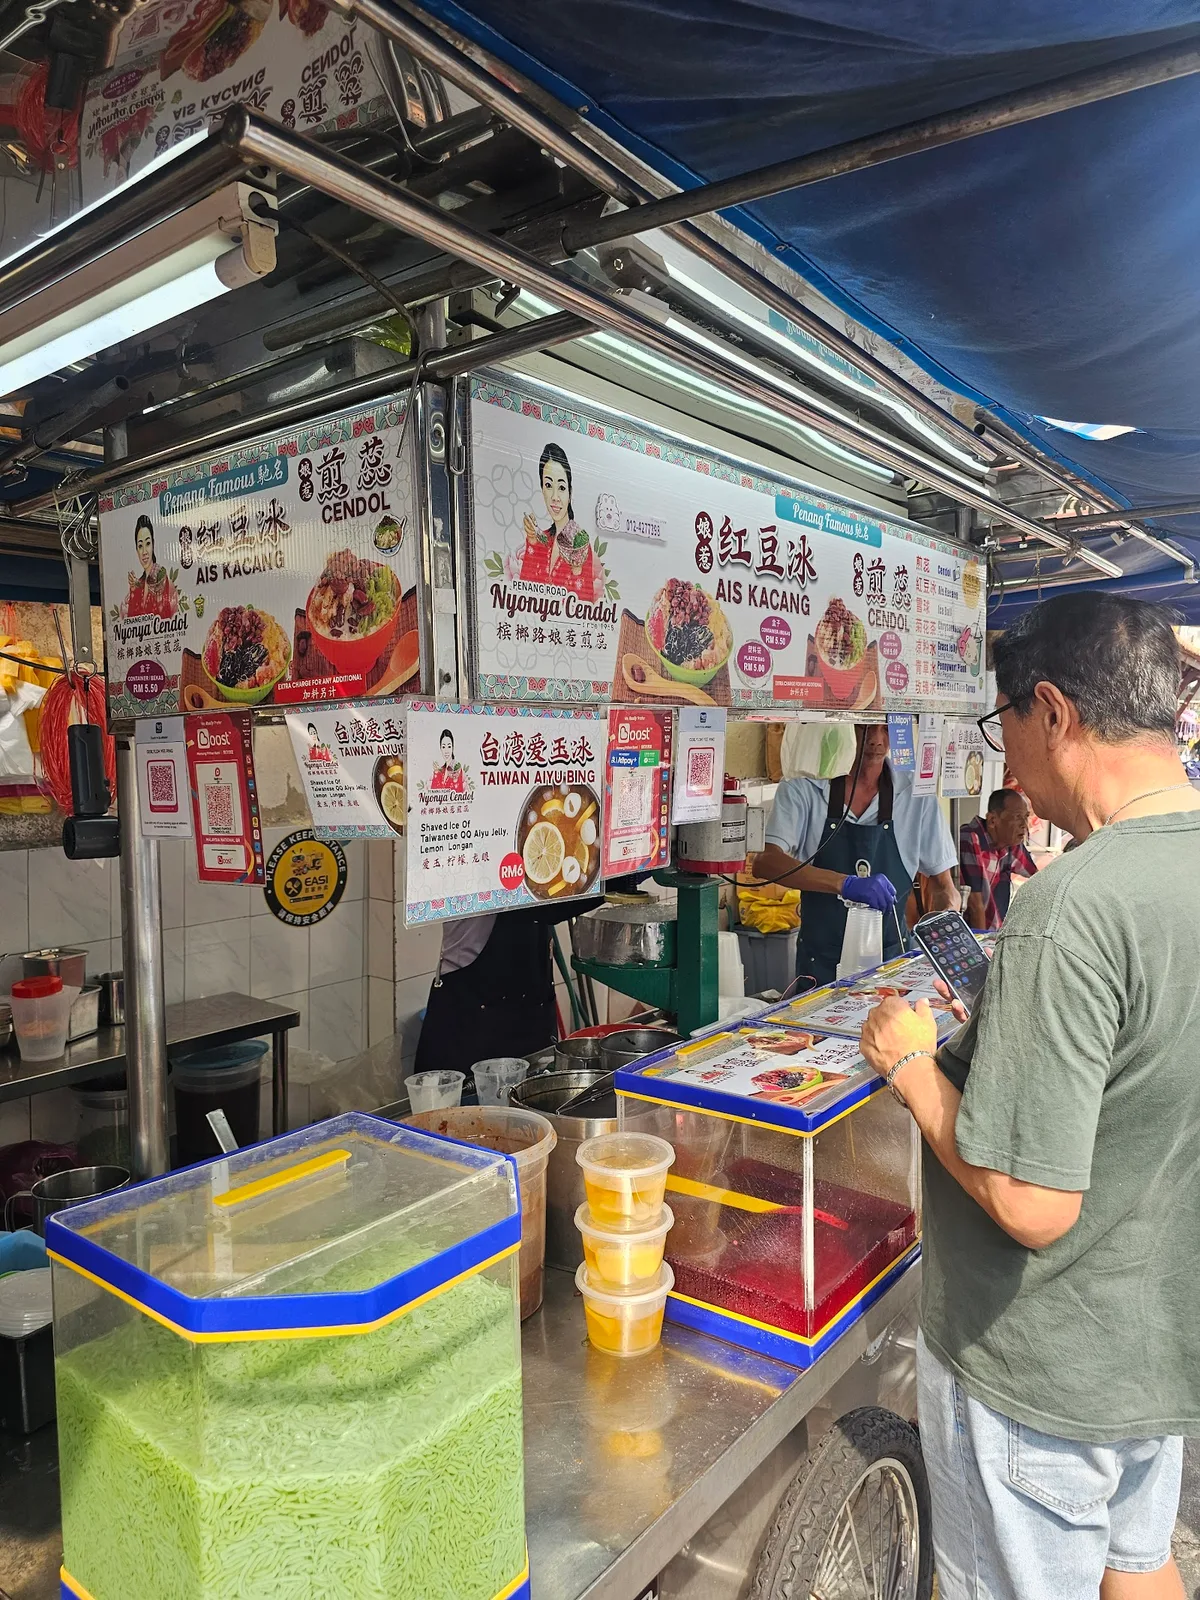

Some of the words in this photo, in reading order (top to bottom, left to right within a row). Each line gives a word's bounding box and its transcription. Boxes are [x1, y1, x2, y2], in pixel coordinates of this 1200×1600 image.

[163, 487, 206, 514] Penang
[208, 472, 255, 497] Famous
[322, 491, 390, 523] CENDOL
[792, 502, 825, 531] Penang
[825, 513, 854, 536] Famous
[696, 517, 712, 571] 娘惹
[718, 515, 818, 588] 红豆冰
[196, 565, 218, 585] AIS
[222, 551, 284, 580] KACANG
[512, 580, 544, 595] PENANG
[546, 586, 567, 597] ROAD
[715, 578, 743, 605] AIS
[748, 584, 810, 616] KACANG
[490, 583, 562, 622] Nyonya
[565, 595, 618, 624] Cendol
[113, 623, 151, 645] Nyonya
[153, 613, 188, 635] Cendol
[868, 607, 910, 632] CENDOL
[496, 621, 608, 650] 槟榔路娘惹煎蕊
[765, 635, 774, 644] RM
[775, 637, 786, 645] 5.50
[744, 662, 753, 671] RM
[753, 664, 765, 673] 5.00
[133, 684, 143, 693] RM
[145, 684, 158, 693] 5.50
[278, 682, 292, 690] EXTRA
[292, 680, 312, 689] CHARGE
[322, 677, 333, 685] ANY
[333, 674, 362, 683] ADDITIONAL
[303, 685, 337, 700] 加料另计
[197, 728, 231, 749] Boost
[618, 723, 650, 743] Boost
[338, 745, 374, 757] TAIWAN
[480, 731, 595, 768] 台湾爱玉冰
[480, 771, 530, 786] TAIWAN
[534, 770, 563, 784] AIYU
[567, 770, 595, 784] BING
[419, 792, 448, 806] Nyonya
[450, 790, 474, 802] Cendol
[421, 822, 448, 832] Shaved
[449, 821, 460, 830] Ice
[462, 820, 471, 829] Of
[421, 832, 458, 843] Taiwanese
[460, 830, 472, 839] QQ
[474, 829, 489, 838] Aiyu
[266, 842, 288, 881] PLEASE
[289, 830, 314, 844] KEEP
[324, 839, 347, 872] STANCE
[420, 845, 444, 854] Lemon
[448, 842, 473, 851] Longan
[304, 875, 329, 887] EASI
[501, 863, 524, 879] RM6
